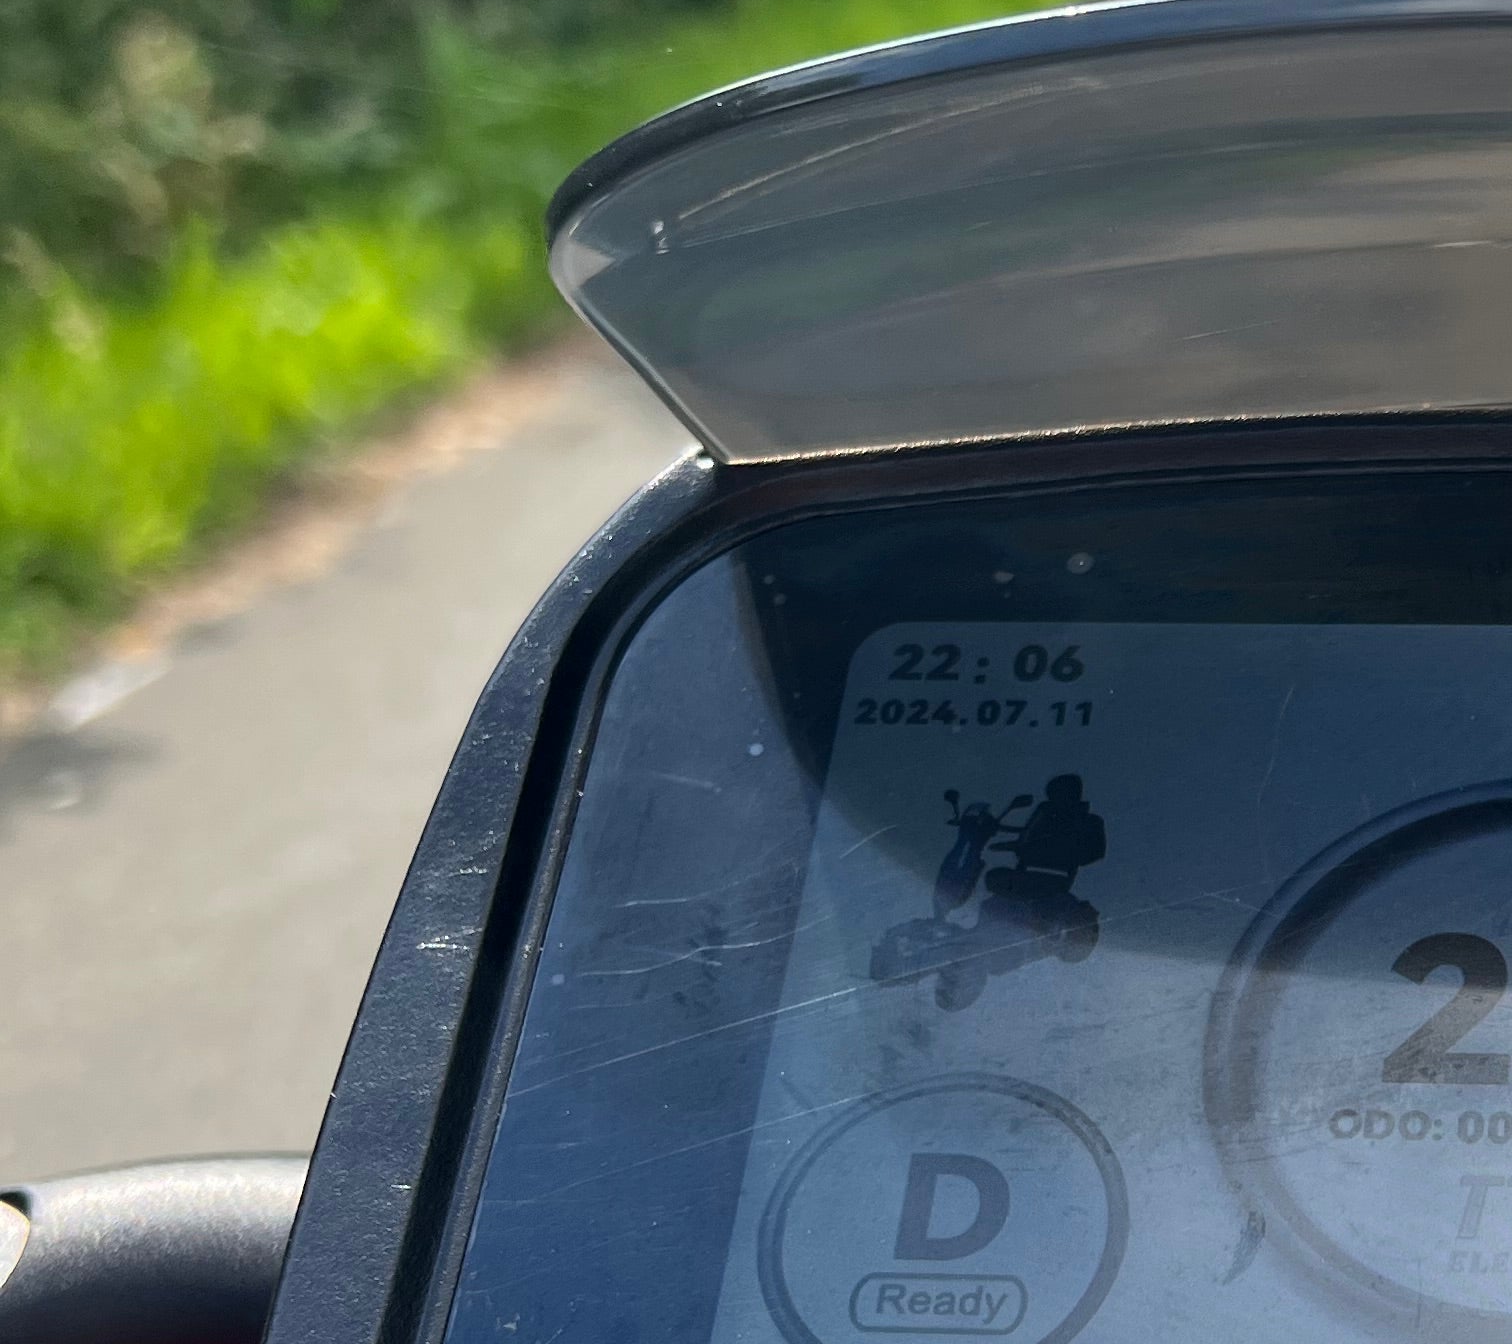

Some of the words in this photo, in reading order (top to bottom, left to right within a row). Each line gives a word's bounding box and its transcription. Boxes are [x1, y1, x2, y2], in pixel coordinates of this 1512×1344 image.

[854, 697, 1094, 728] 2024.07.11
[1328, 1108, 1443, 1142] ODO:
[893, 1152, 1011, 1261] D
[875, 1282, 1009, 1325] Ready
